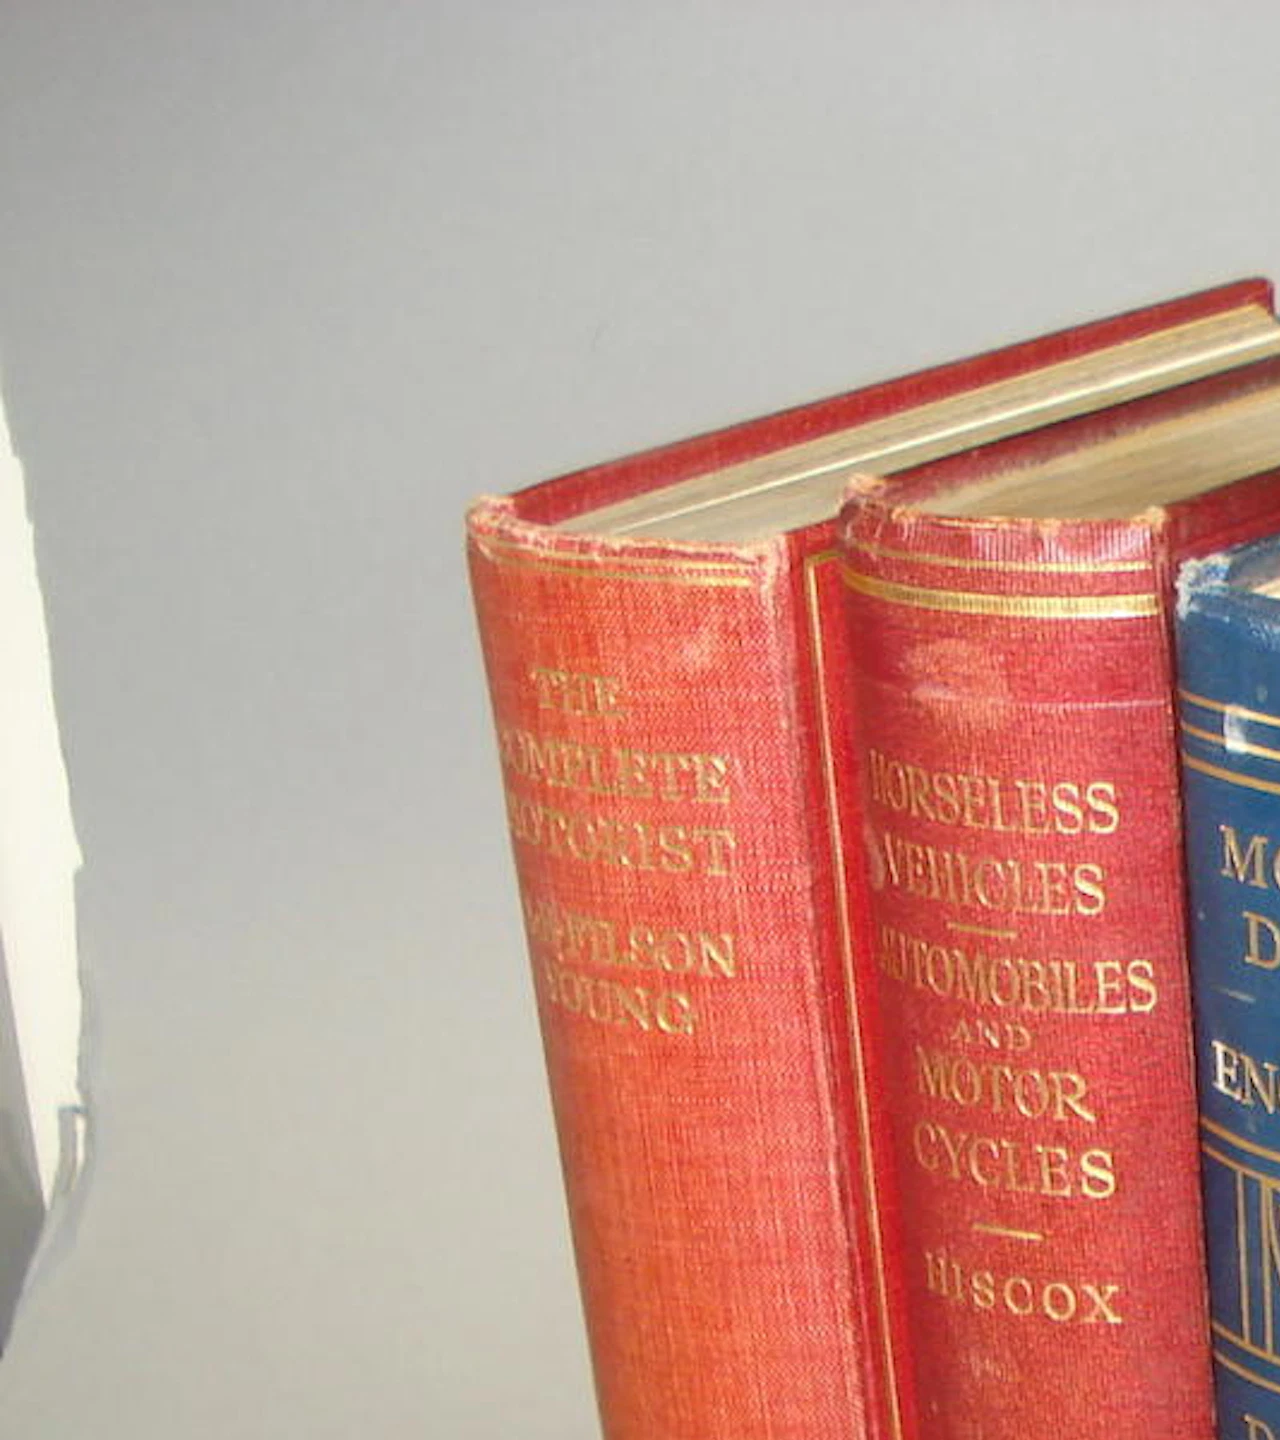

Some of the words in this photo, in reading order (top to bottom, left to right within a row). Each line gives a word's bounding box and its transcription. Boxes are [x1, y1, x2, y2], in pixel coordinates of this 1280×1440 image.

[530, 667, 625, 718] THE
[502, 729, 730, 804] OMPLETE
[868, 748, 1120, 835] HORSELESS
[885, 832, 1107, 916] VEHICLES
[951, 1019, 1033, 1050] AND
[916, 1046, 1096, 1122] MOTOR
[914, 1122, 1117, 1200] CYCLES
[925, 1253, 1122, 1324] HISCOX
